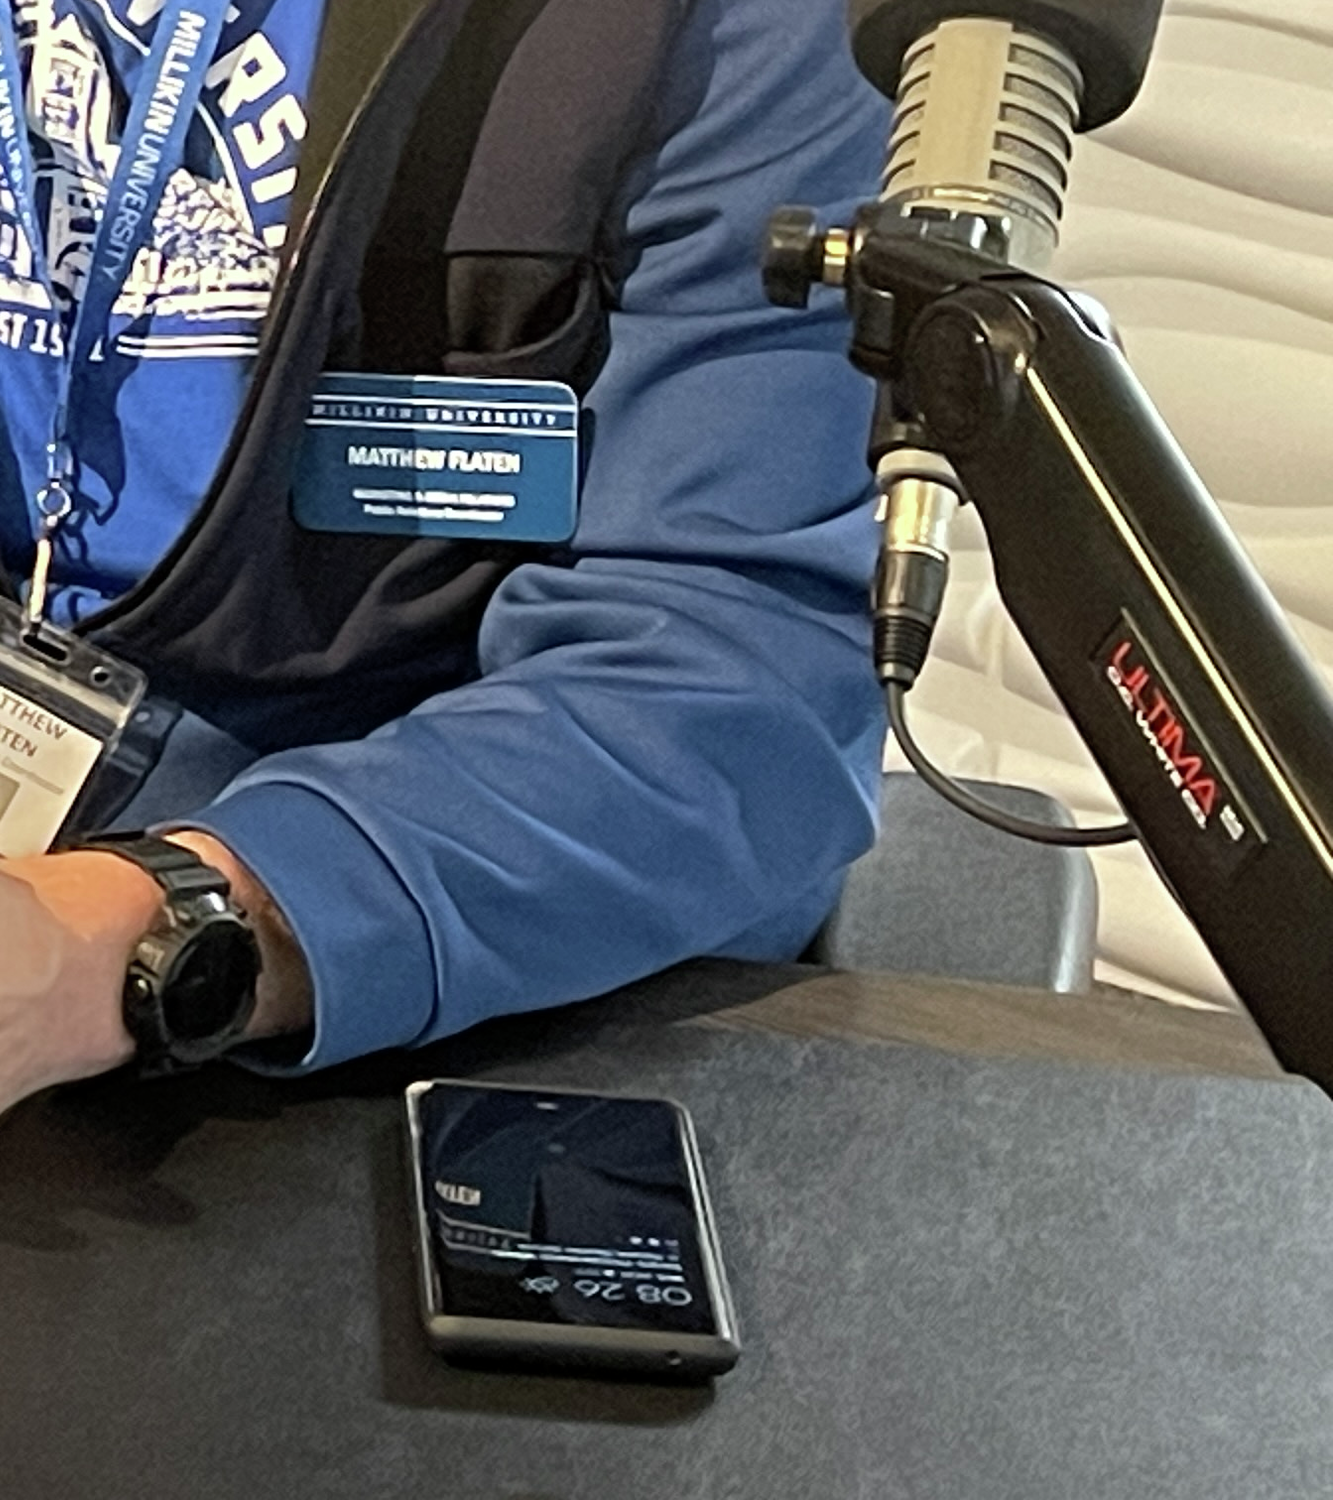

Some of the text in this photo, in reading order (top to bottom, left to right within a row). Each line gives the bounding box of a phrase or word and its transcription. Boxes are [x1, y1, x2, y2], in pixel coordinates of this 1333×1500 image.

[98, 10, 207, 281] MILLIKIN UNIVERSITY
[348, 447, 521, 474] MATTHEW FLATEN
[426, 408, 557, 426] UNIVERSITY
[1112, 641, 1216, 816] ULTIMA
